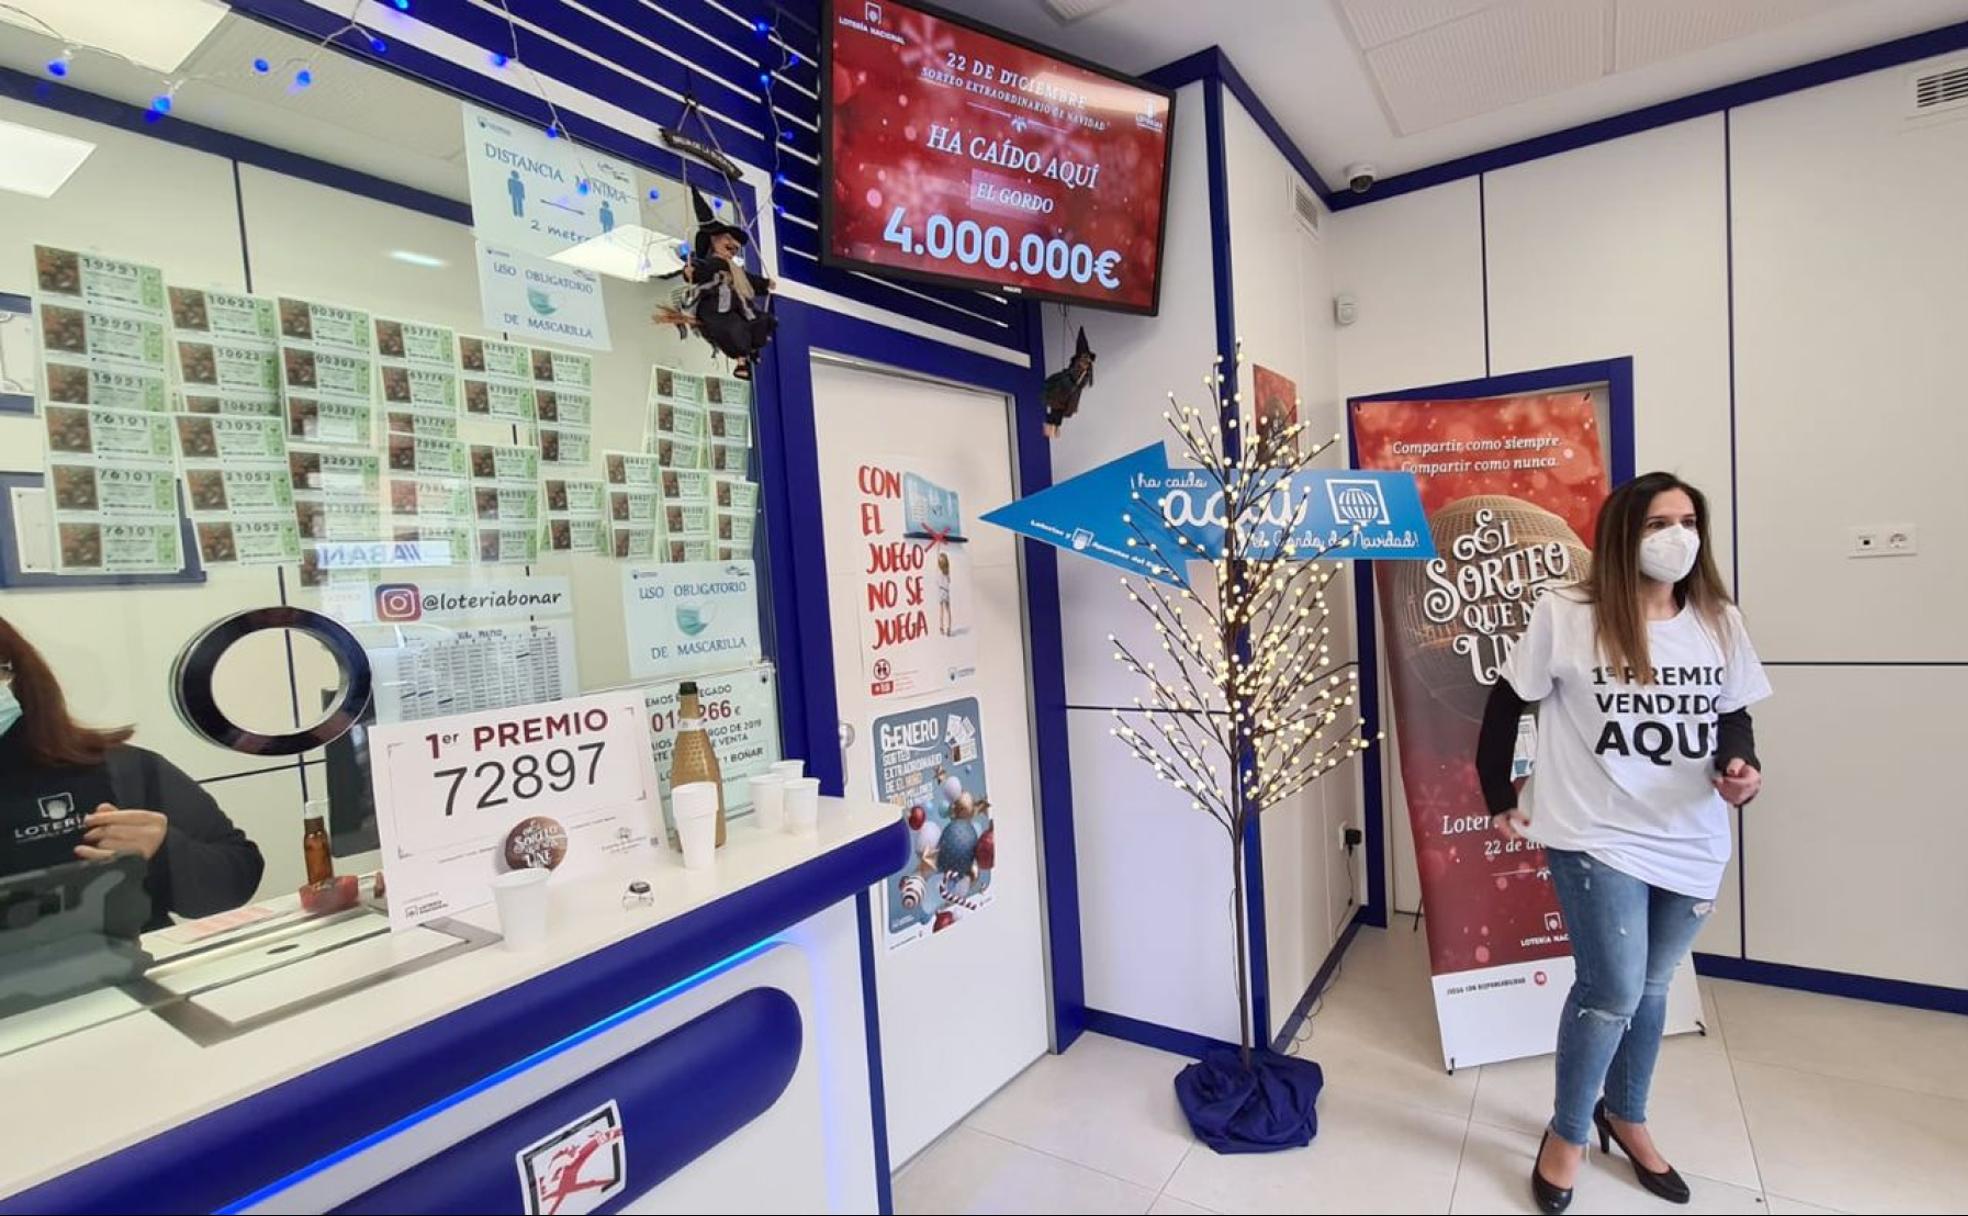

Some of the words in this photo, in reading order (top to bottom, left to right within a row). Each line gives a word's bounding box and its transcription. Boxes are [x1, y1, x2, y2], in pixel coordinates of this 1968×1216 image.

[946, 52, 967, 71] 22
[971, 59, 995, 80] DE
[999, 67, 1088, 110] DICIEMBRE
[920, 66, 963, 88] SORTEO
[964, 78, 1051, 116] EXTRAORDINARIO
[1067, 109, 1107, 131] NAVIDAD
[484, 143, 565, 184] DISTANCIA
[927, 123, 964, 157] HA
[969, 136, 1042, 175] CAÍDO
[1045, 160, 1099, 190] AQUÍ
[976, 181, 996, 200] EL
[998, 188, 1055, 214] GORDO
[530, 219, 541, 232] 2
[883, 206, 1122, 289] 4.000.000€
[493, 261, 517, 277] USO
[525, 268, 594, 294] OBLIGATORIO
[503, 311, 519, 326] DE
[527, 315, 594, 339] MASCARILLA
[1391, 437, 1463, 457] Compartir
[1465, 439, 1503, 453] como
[858, 464, 902, 499] CON
[1401, 456, 1471, 477] Compartir
[1473, 458, 1511, 472] como
[861, 502, 885, 536] EL
[1452, 508, 1519, 562] EL
[866, 542, 925, 575] JUEGO
[639, 586, 665, 599] USO
[674, 581, 747, 598] OBLIGATORIO
[867, 580, 898, 612] NO
[905, 576, 924, 606] SE
[1423, 541, 1571, 623] SORTEO
[423, 589, 562, 611] @loteriabonar
[872, 610, 928, 650] JUEGA
[1463, 601, 1518, 634] QUE
[652, 647, 669, 660] DE
[677, 637, 747, 656] MASCARILLA
[425, 731, 460, 760] 1er
[473, 708, 609, 752] PREMIO
[892, 717, 939, 750] ENERO
[433, 741, 606, 817] 72897
[1484, 839, 1502, 856] 22
[1505, 835, 1522, 853] de
